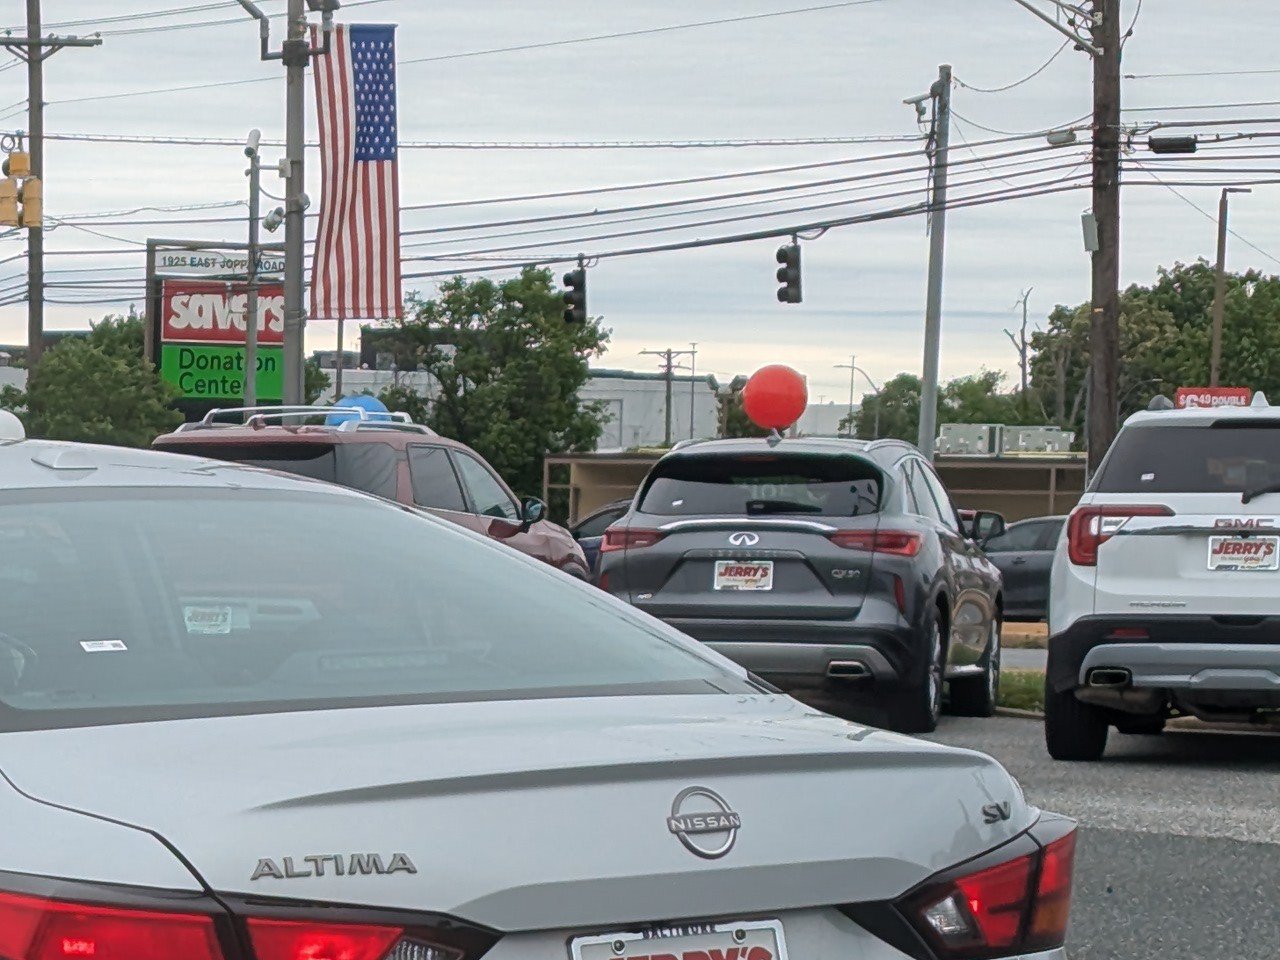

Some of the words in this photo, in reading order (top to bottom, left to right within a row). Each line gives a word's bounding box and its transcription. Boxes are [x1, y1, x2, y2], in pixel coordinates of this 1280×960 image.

[161, 256, 187, 267] 1925
[189, 256, 217, 268] EAST
[220, 258, 250, 270] JOPP
[179, 347, 276, 373] Donaton
[178, 371, 242, 395] Cente
[1213, 518, 1275, 529] GMC
[1212, 541, 1276, 556] JERRY'S
[718, 565, 770, 579] JERRY'S
[982, 800, 1012, 825] SV
[670, 815, 740, 832] NISSAN
[250, 850, 418, 881] ALTIMA
